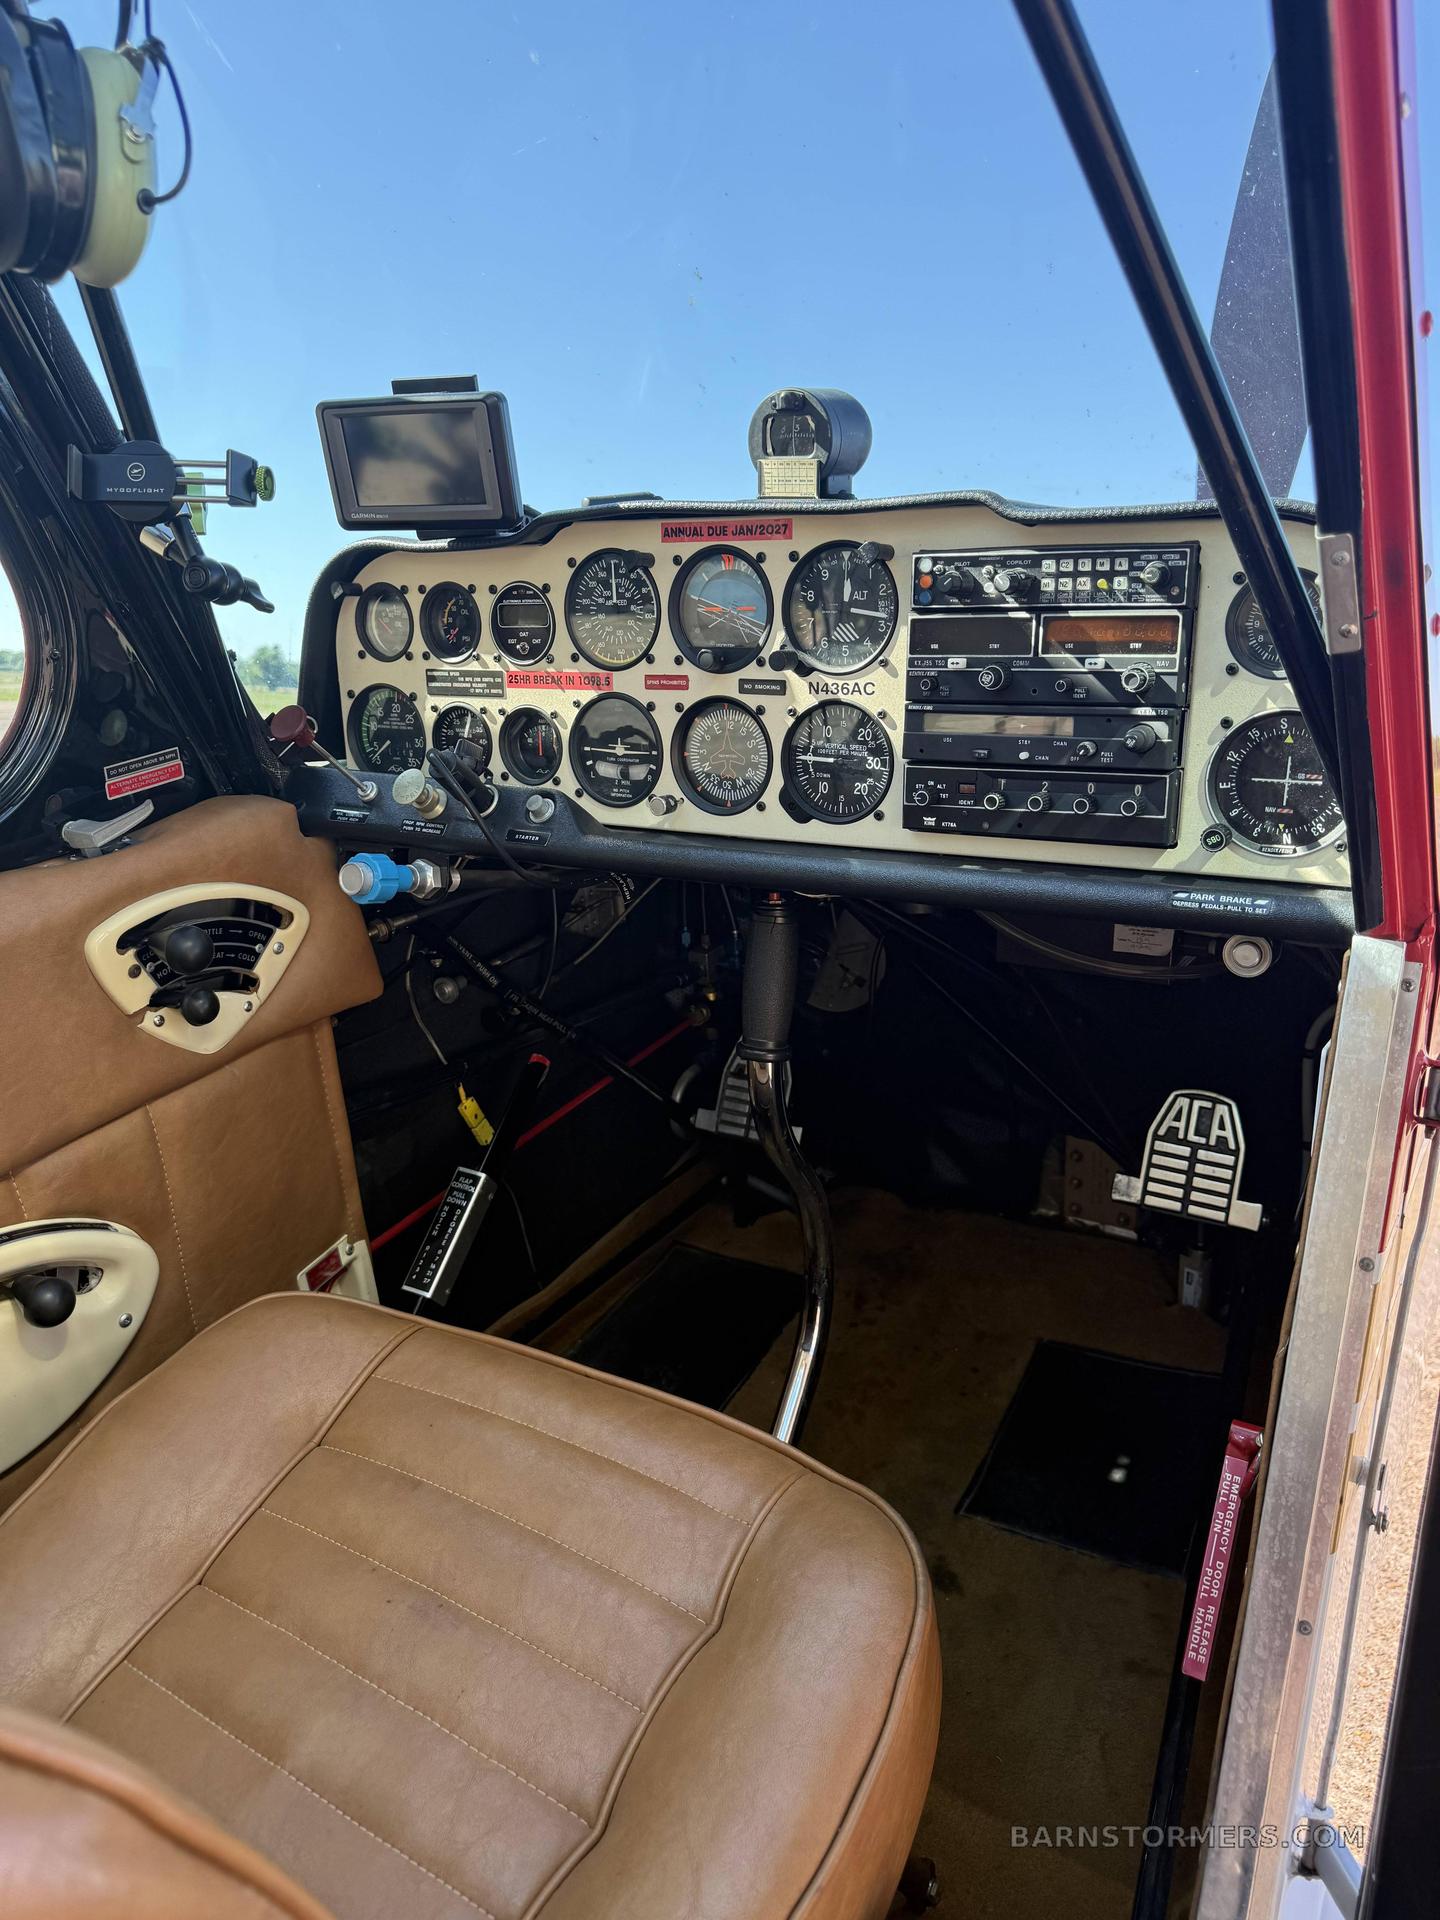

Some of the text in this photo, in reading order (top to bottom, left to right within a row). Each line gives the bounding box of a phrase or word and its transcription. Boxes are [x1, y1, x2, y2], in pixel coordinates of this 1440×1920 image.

[663, 523, 788, 538] ANNUAL DUE JAN/2027
[1061, 561, 1069, 569] C2
[821, 569, 829, 580] 9
[1043, 580, 1050, 588] N1
[1077, 579, 1087, 587] AX
[879, 584, 887, 595] 2
[807, 590, 814, 601] 8
[853, 591, 868, 600] ALT
[807, 618, 814, 628] 7
[878, 620, 886, 632] 3
[821, 637, 828, 648] 6
[864, 637, 871, 647] 4
[842, 646, 849, 656] 5
[1268, 644, 1273, 652] 7
[508, 675, 531, 684] 25HR
[533, 675, 563, 685] BREAK
[566, 676, 575, 685] IN
[578, 676, 610, 686] 1098.5
[808, 682, 875, 696] N436AC
[392, 704, 400, 712] 20
[405, 714, 414, 724] 25
[1280, 718, 1288, 729] S
[713, 722, 722, 734] E
[728, 721, 734, 729] 12
[704, 733, 711, 741] 6
[822, 726, 832, 738] 10
[858, 729, 872, 741] 20
[1248, 728, 1260, 740] 15
[373, 742, 378, 750] 5
[414, 738, 423, 747] 30
[747, 740, 756, 748] S
[1226, 750, 1239, 762] 12
[408, 758, 416, 767] 35
[702, 762, 712, 772] N
[866, 757, 880, 769] 30
[110, 778, 138, 789] ALTERNATE
[139, 770, 167, 780] EMERGENCY
[736, 776, 746, 788] W
[867, 778, 874, 786] 25
[1220, 781, 1231, 789] E
[819, 782, 828, 793] 10
[854, 783, 868, 795] 20
[1042, 782, 1142, 796] 2 0 0
[1311, 824, 1325, 836] 33
[1283, 833, 1292, 844] N
[1190, 893, 1252, 904] PARK BRAKE
[248, 930, 266, 941] OPEN
[237, 953, 256, 962] COLD
[477, 961, 491, 977] PUSH
[1157, 1097, 1236, 1150] ACA
[451, 1182, 476, 1192] CONTROL
[453, 1191, 466, 1199] PULL
[447, 1196, 467, 1207] DOWN
[1219, 1472, 1231, 1504] PULL
[1197, 1474, 1241, 1664] EMERGENCY DOOR RELEASE
[1188, 1607, 1205, 1662] HANDLE
